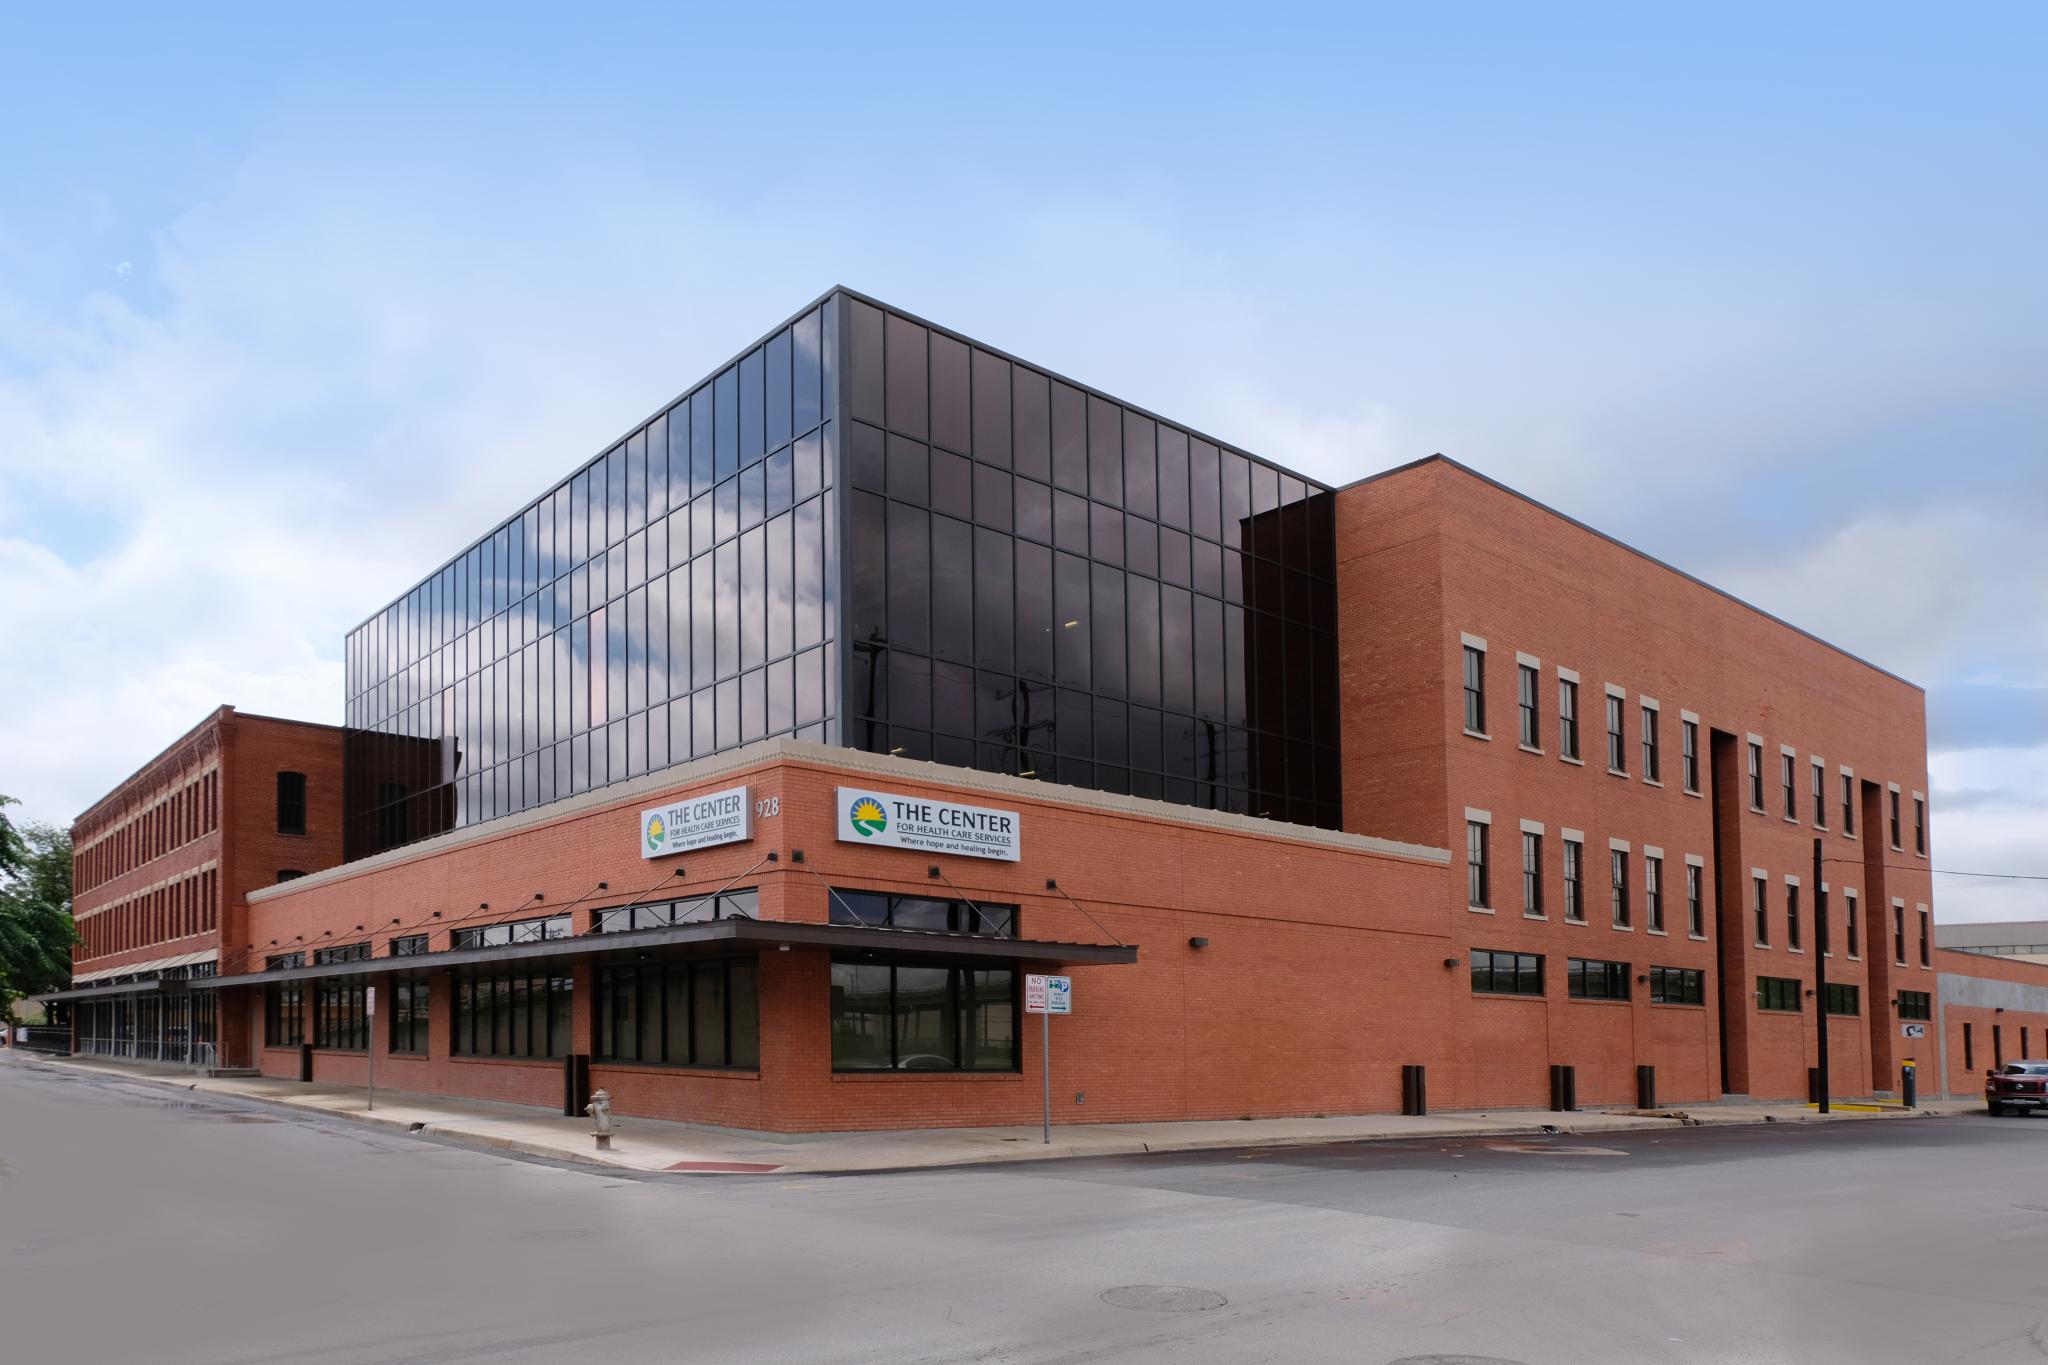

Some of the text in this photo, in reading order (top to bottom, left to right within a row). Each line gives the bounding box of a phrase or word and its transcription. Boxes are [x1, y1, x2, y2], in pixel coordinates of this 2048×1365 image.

[668, 795, 740, 826] THE CENTER
[757, 797, 779, 817] 928
[892, 801, 1011, 833] THE CENTER
[670, 815, 740, 837] FOR HEALTH CARE SERVICES
[897, 822, 1011, 845] FOR HEALTH CARE SERVICES
[672, 840, 686, 849] Where
[686, 838, 697, 847] hope
[707, 833, 723, 843] healing
[723, 830, 738, 841] begin.
[900, 835, 1009, 857] Where hope and healing begin.
